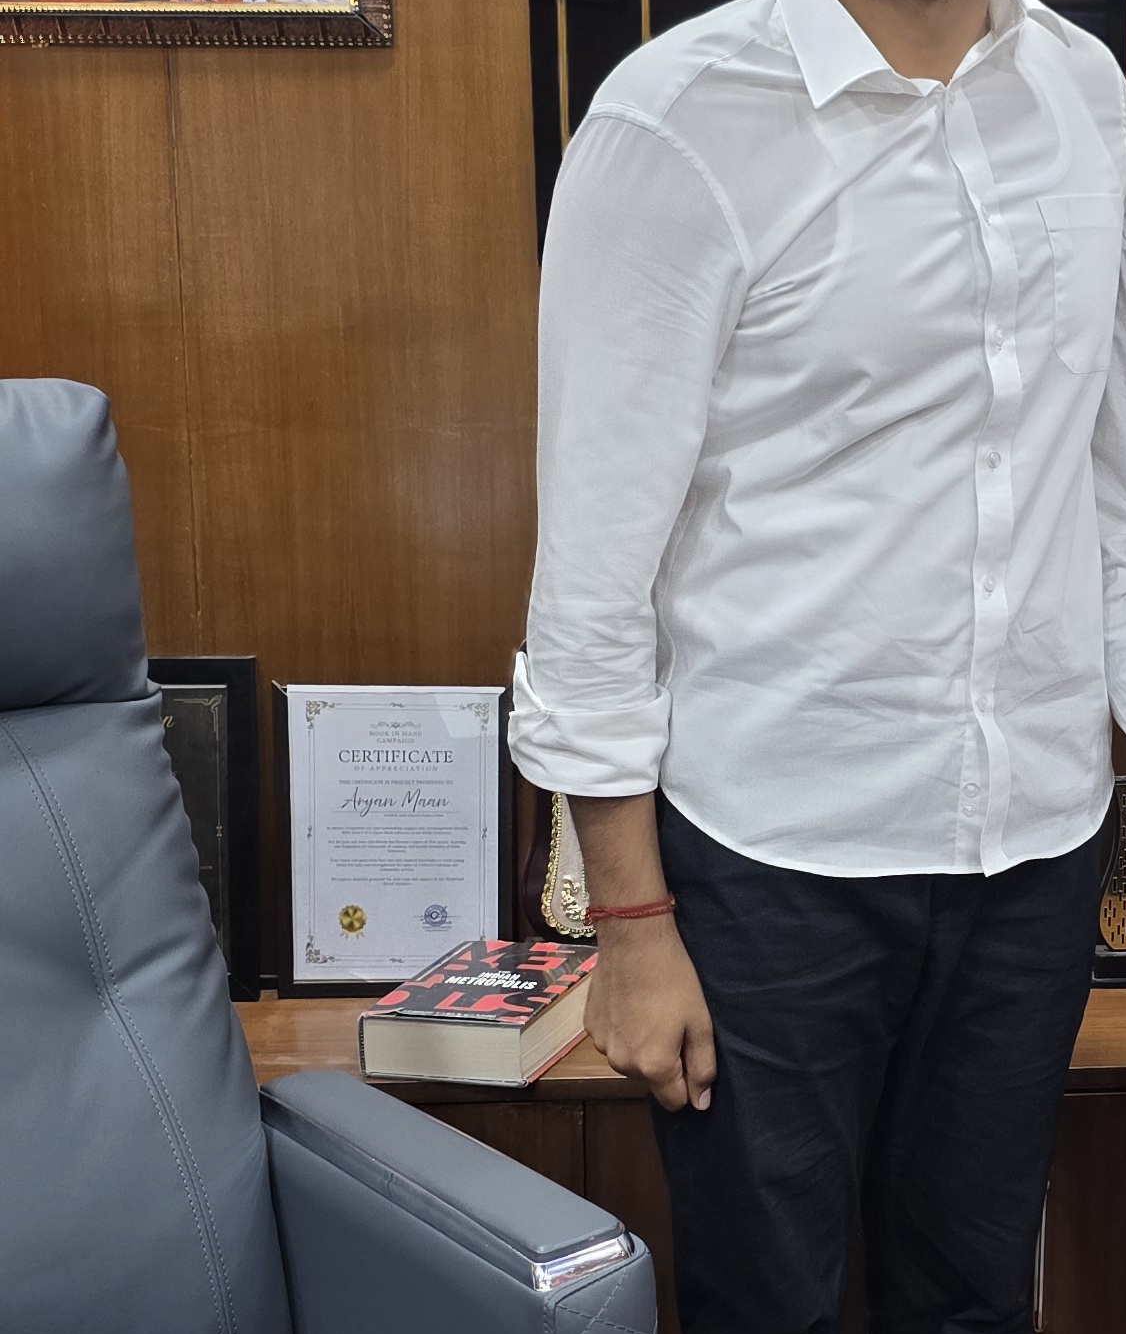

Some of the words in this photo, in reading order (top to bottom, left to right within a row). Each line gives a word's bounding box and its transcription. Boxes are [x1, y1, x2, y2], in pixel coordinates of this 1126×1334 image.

[338, 750, 453, 763] CERTIFICATE
[341, 786, 397, 817] Aryan
[401, 788, 450, 812] Maan
[445, 975, 537, 990] METROPOLIS
[478, 971, 520, 981] INDIAN
